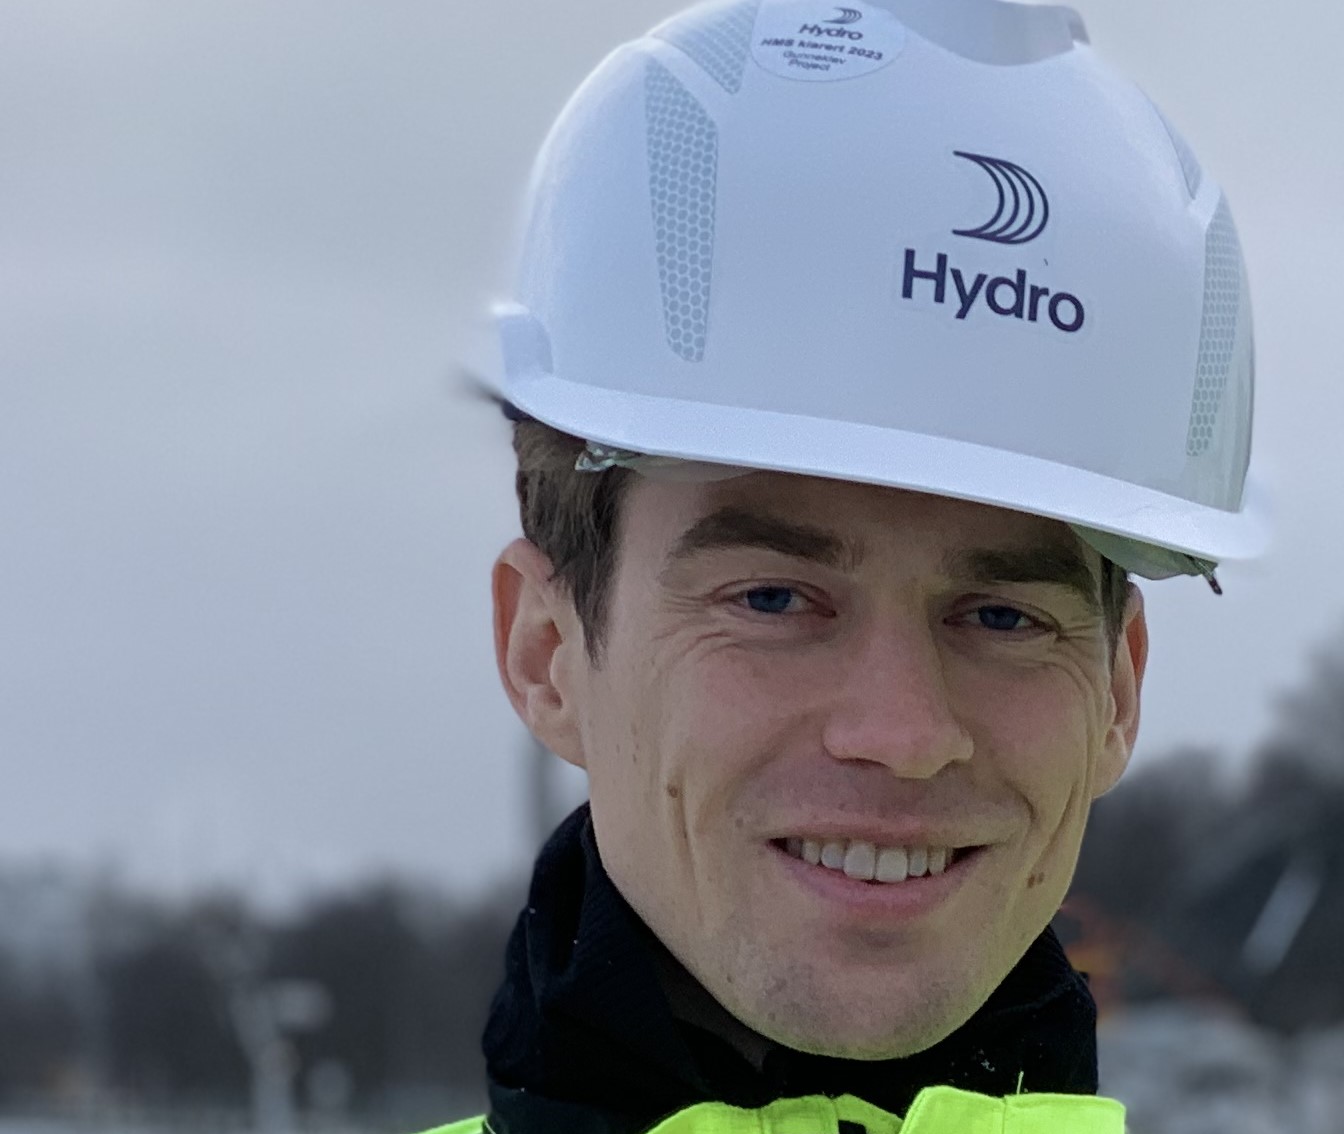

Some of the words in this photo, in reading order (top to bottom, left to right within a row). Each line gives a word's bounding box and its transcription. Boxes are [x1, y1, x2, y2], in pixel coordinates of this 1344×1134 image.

[798, 23, 864, 41] Hydro
[760, 38, 795, 47] HMS
[798, 39, 846, 53] klarert
[848, 47, 884, 61] 2023
[788, 59, 831, 72] Project
[900, 248, 1086, 334] Hydro
